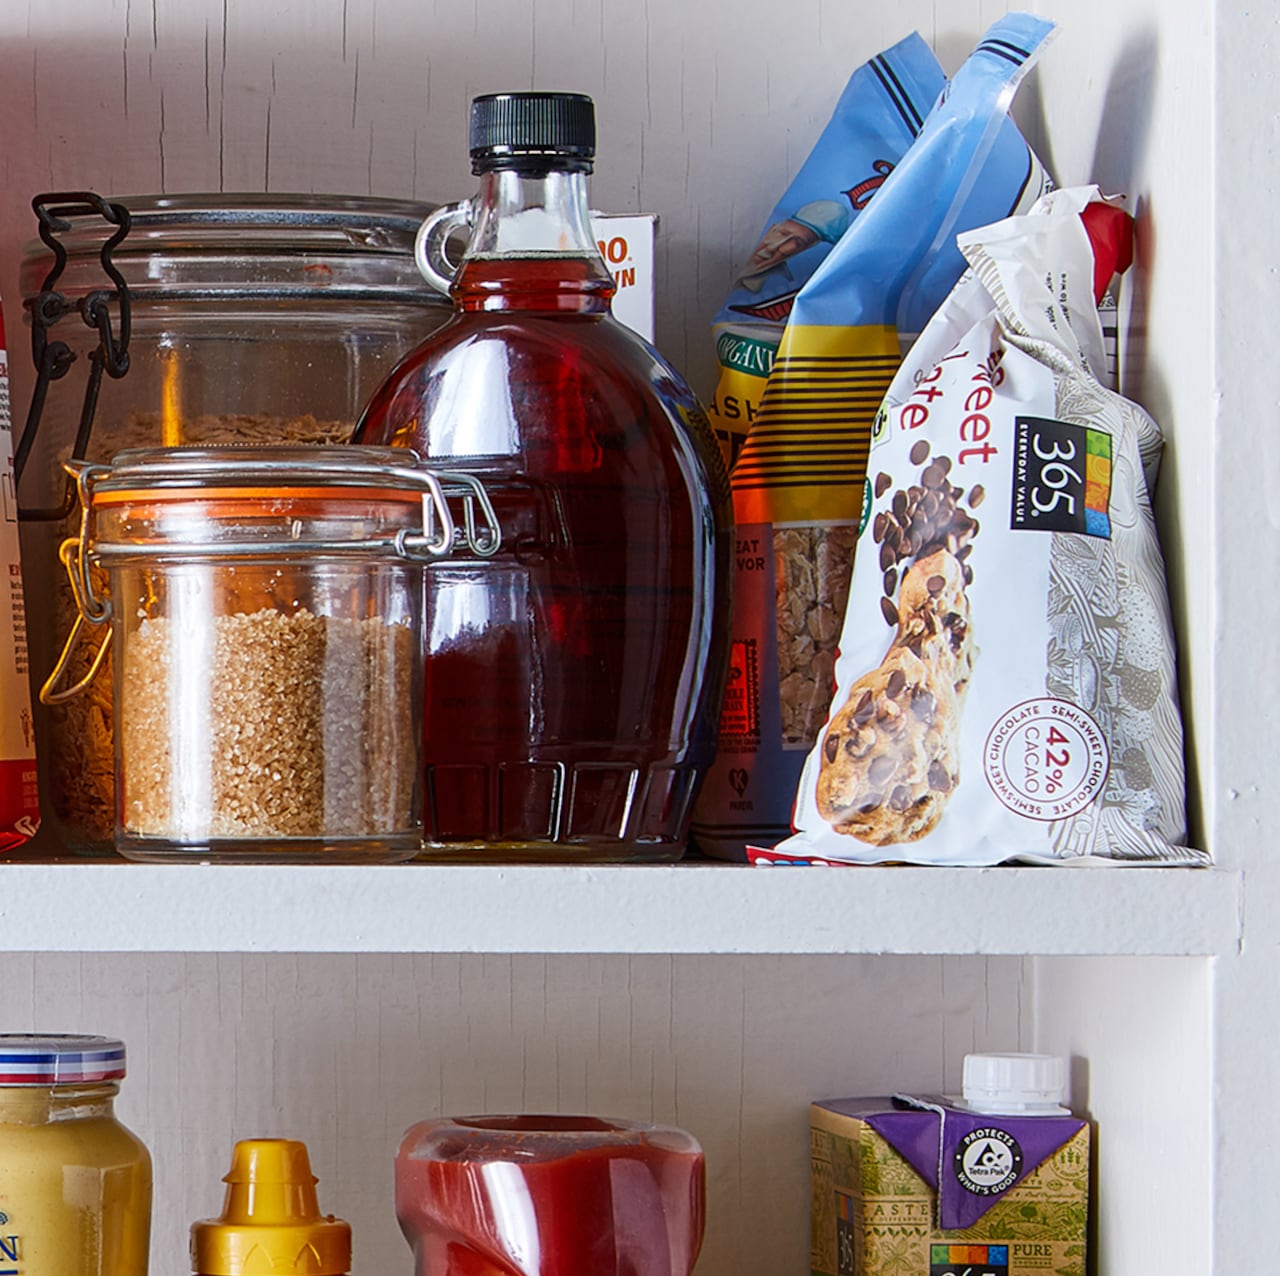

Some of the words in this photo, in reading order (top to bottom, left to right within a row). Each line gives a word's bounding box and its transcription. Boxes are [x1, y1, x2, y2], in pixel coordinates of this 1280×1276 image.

[1016, 424, 1028, 482] EVERYDAY
[1031, 434, 1083, 518] 365
[1015, 484, 1028, 524] VALUE
[989, 705, 1040, 761] CHOCOLATE
[1024, 726, 1040, 793] CACAO
[1045, 726, 1070, 794] 42%
[1052, 760, 1103, 815] CHOCOLATE
[963, 1128, 1015, 1148] PROTECTS
[956, 1171, 989, 1195] WHAT'S
[991, 1170, 1019, 1194] GOOD
[968, 1168, 989, 1177] Tetra
[1013, 1244, 1052, 1257] PURE
